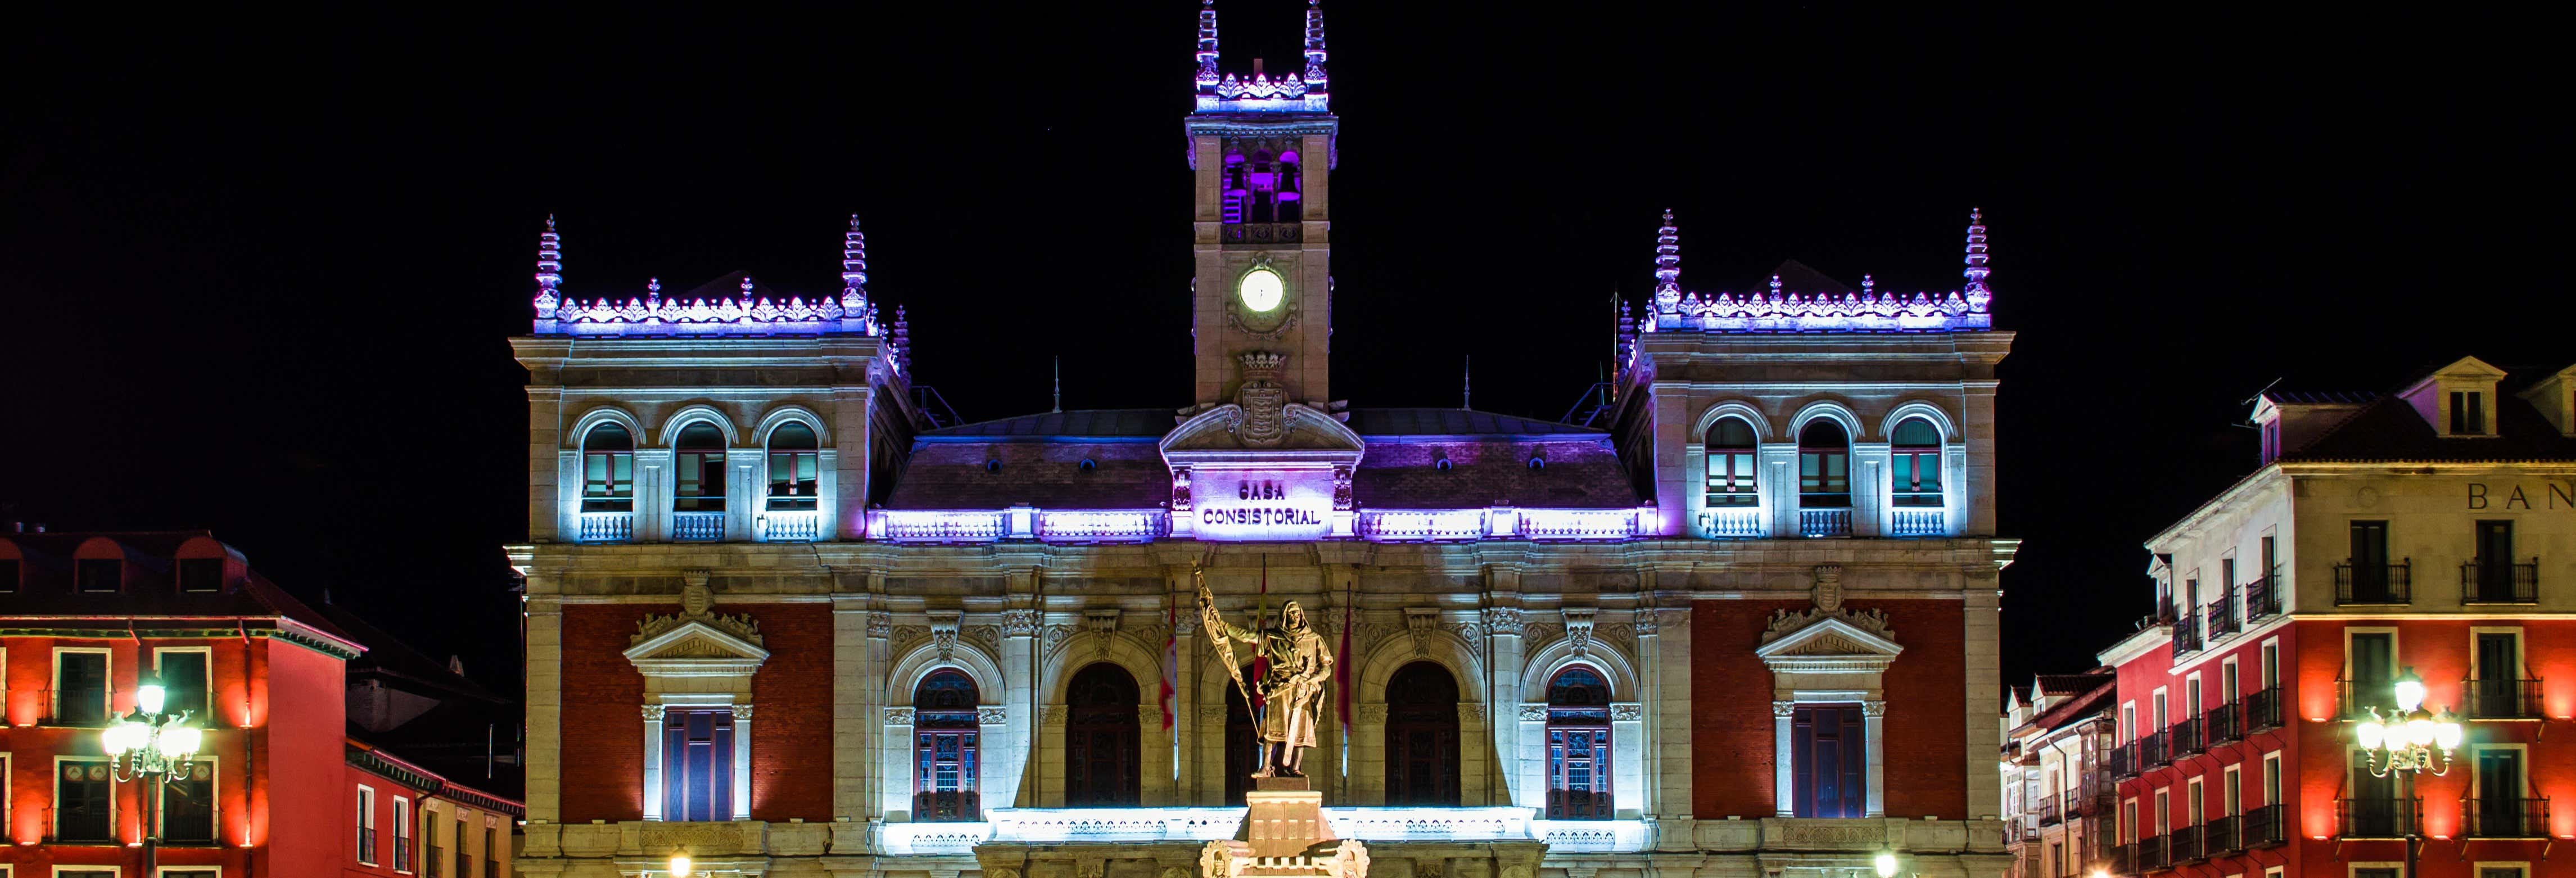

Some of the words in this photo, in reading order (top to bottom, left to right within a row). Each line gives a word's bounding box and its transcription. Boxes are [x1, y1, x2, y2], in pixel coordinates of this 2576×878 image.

[1239, 483, 1285, 500] CASA
[2467, 483, 2576, 509] BAN
[1203, 508, 1321, 526] CONSISTORIAL
